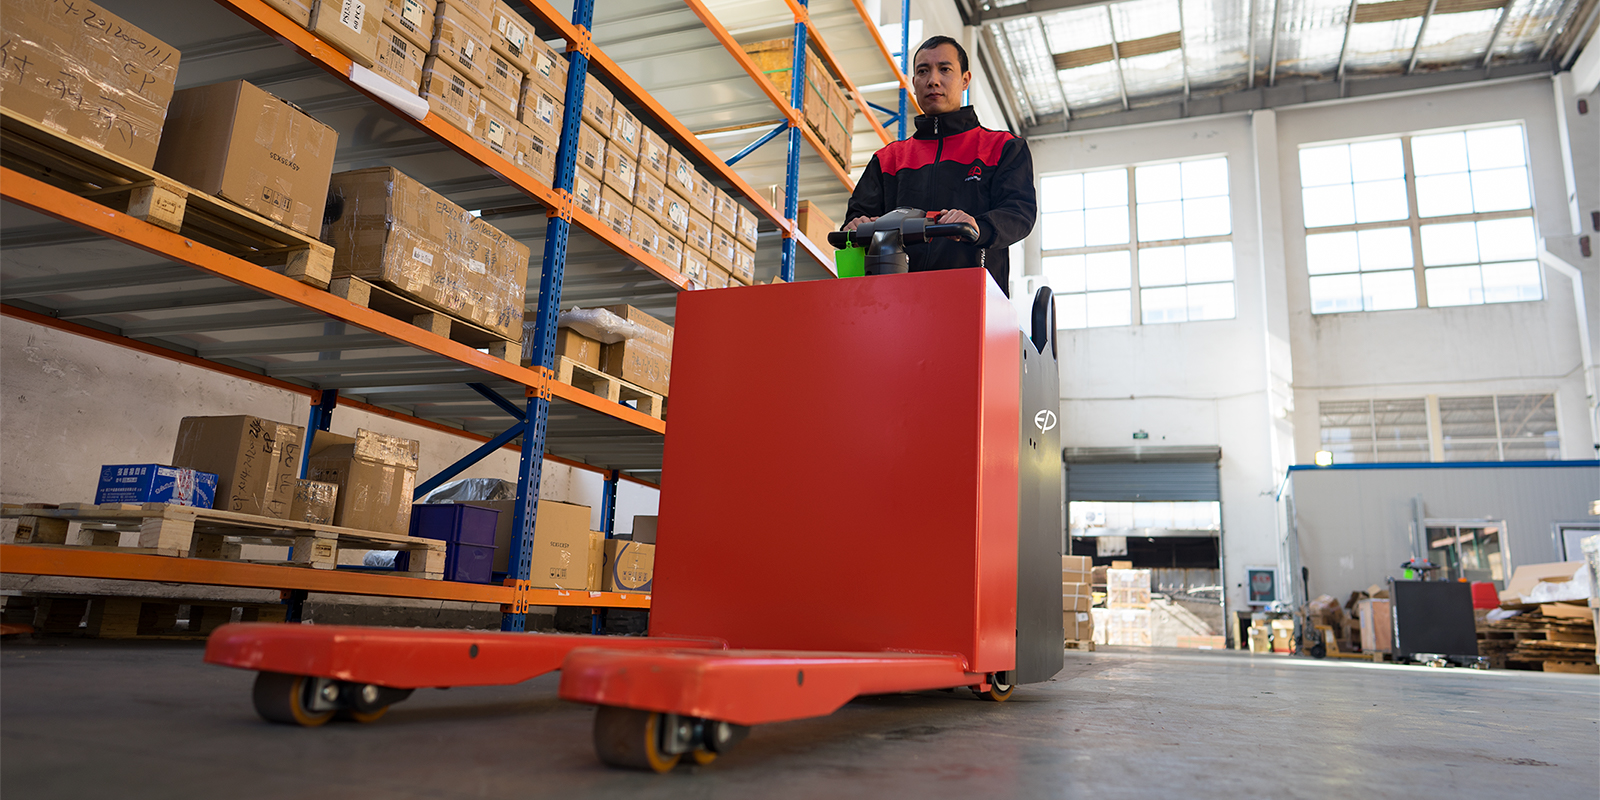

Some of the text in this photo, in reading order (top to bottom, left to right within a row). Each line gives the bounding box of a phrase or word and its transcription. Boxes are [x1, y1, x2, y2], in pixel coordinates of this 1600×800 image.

[269, 151, 300, 171] 45X35X35
[1034, 409, 1057, 435] EP
[262, 432, 276, 454] EP
